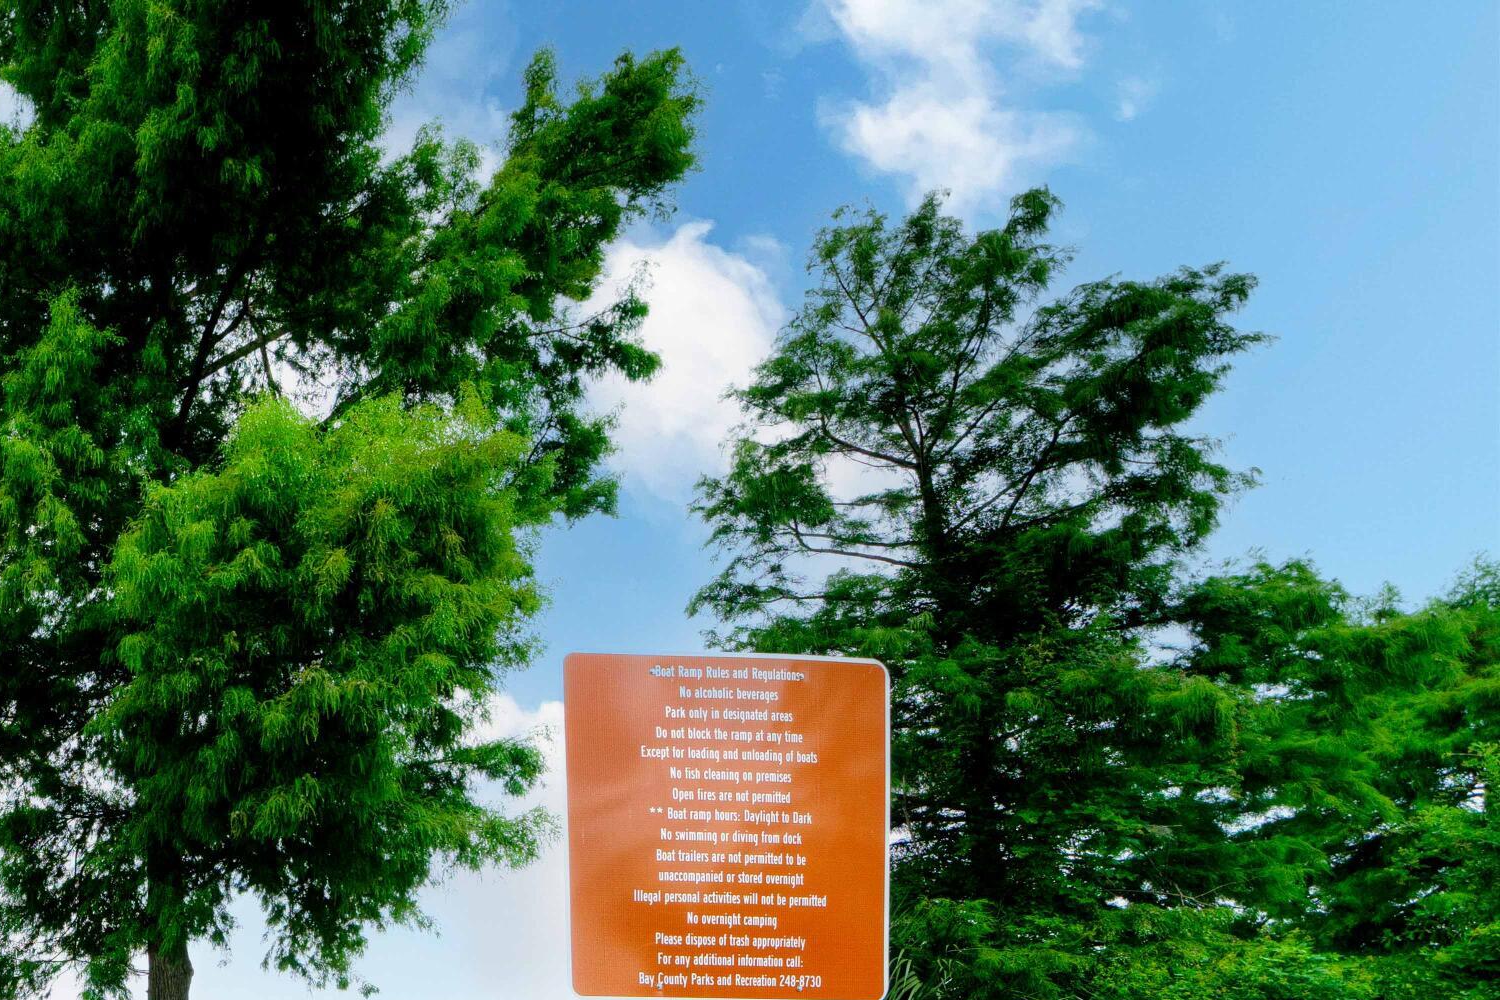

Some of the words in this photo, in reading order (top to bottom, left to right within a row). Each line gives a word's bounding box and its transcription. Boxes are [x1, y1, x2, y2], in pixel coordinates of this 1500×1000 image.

[655, 665, 674, 677] Boat
[678, 665, 702, 680] Ramp
[706, 667, 730, 678] Rules
[733, 668, 748, 680] and
[752, 668, 800, 683] Regulations
[679, 686, 691, 698] No
[695, 687, 733, 699] alcoholic
[737, 688, 778, 703] beverages
[665, 706, 685, 718] Park
[689, 708, 708, 722] only
[712, 708, 719, 719] in
[723, 708, 768, 723] designated
[771, 711, 793, 722] areas
[656, 727, 667, 738] Do
[671, 729, 684, 739] not
[688, 728, 711, 740] block
[714, 728, 728, 740] the
[731, 731, 752, 743] ramp
[756, 731, 764, 742] at
[767, 733, 782, 745] any
[784, 731, 803, 743] time
[641, 745, 669, 760] Except
[672, 747, 684, 758] for
[688, 747, 720, 762] loading
[723, 748, 738, 760] and
[742, 749, 782, 765] unloading
[786, 750, 793, 762] of
[797, 752, 818, 763] boats
[670, 767, 682, 779] No
[685, 768, 700, 779] fish
[704, 768, 739, 784] cleaning
[743, 772, 752, 781] on
[756, 772, 791, 783] premises
[672, 788, 694, 802] Open
[698, 788, 716, 800] fires
[719, 791, 732, 801] are
[736, 791, 749, 802] not
[752, 792, 791, 805] permitted
[668, 808, 687, 820] Boat
[690, 811, 712, 823] ramp
[715, 809, 741, 822] hours:
[744, 810, 779, 826] Daylight
[782, 812, 789, 823] to
[793, 812, 812, 824] Dark
[660, 828, 672, 840] No
[675, 831, 717, 846] swimming
[721, 833, 729, 842] or
[732, 831, 758, 846] diving
[762, 832, 780, 843] from
[783, 832, 802, 844] dock
[656, 849, 676, 862] Boat
[678, 849, 709, 862] trailers
[712, 853, 725, 863] are
[728, 852, 742, 863] not
[745, 852, 782, 866] permitted
[786, 855, 793, 865] to
[797, 854, 806, 866] be
[658, 871, 723, 885] unaccompanied
[726, 873, 735, 882] or
[738, 872, 763, 884] stored
[766, 873, 804, 888] overnight
[634, 889, 661, 906] Illegal
[665, 892, 700, 905] personal
[703, 892, 740, 904] activities
[743, 893, 758, 905] will
[761, 895, 774, 905] not
[777, 894, 786, 905] be
[789, 895, 827, 908] permitted
[687, 912, 698, 924] No
[702, 913, 741, 929] overnight
[744, 915, 778, 929] camping
[655, 932, 682, 945] Please
[686, 933, 716, 948] dispose
[719, 934, 727, 946] of
[730, 934, 750, 947] trash
[752, 936, 806, 950] appropriately
[658, 952, 671, 965] For
[675, 955, 690, 968] any
[693, 953, 734, 966] additional
[738, 954, 783, 967] information
[786, 955, 803, 968] call:
[639, 972, 654, 988] Bay
[658, 972, 688, 988] County
[691, 973, 714, 985] Parks
[717, 974, 732, 986] and
[735, 974, 777, 987] Recreation
[779, 975, 821, 988] 248-8730
